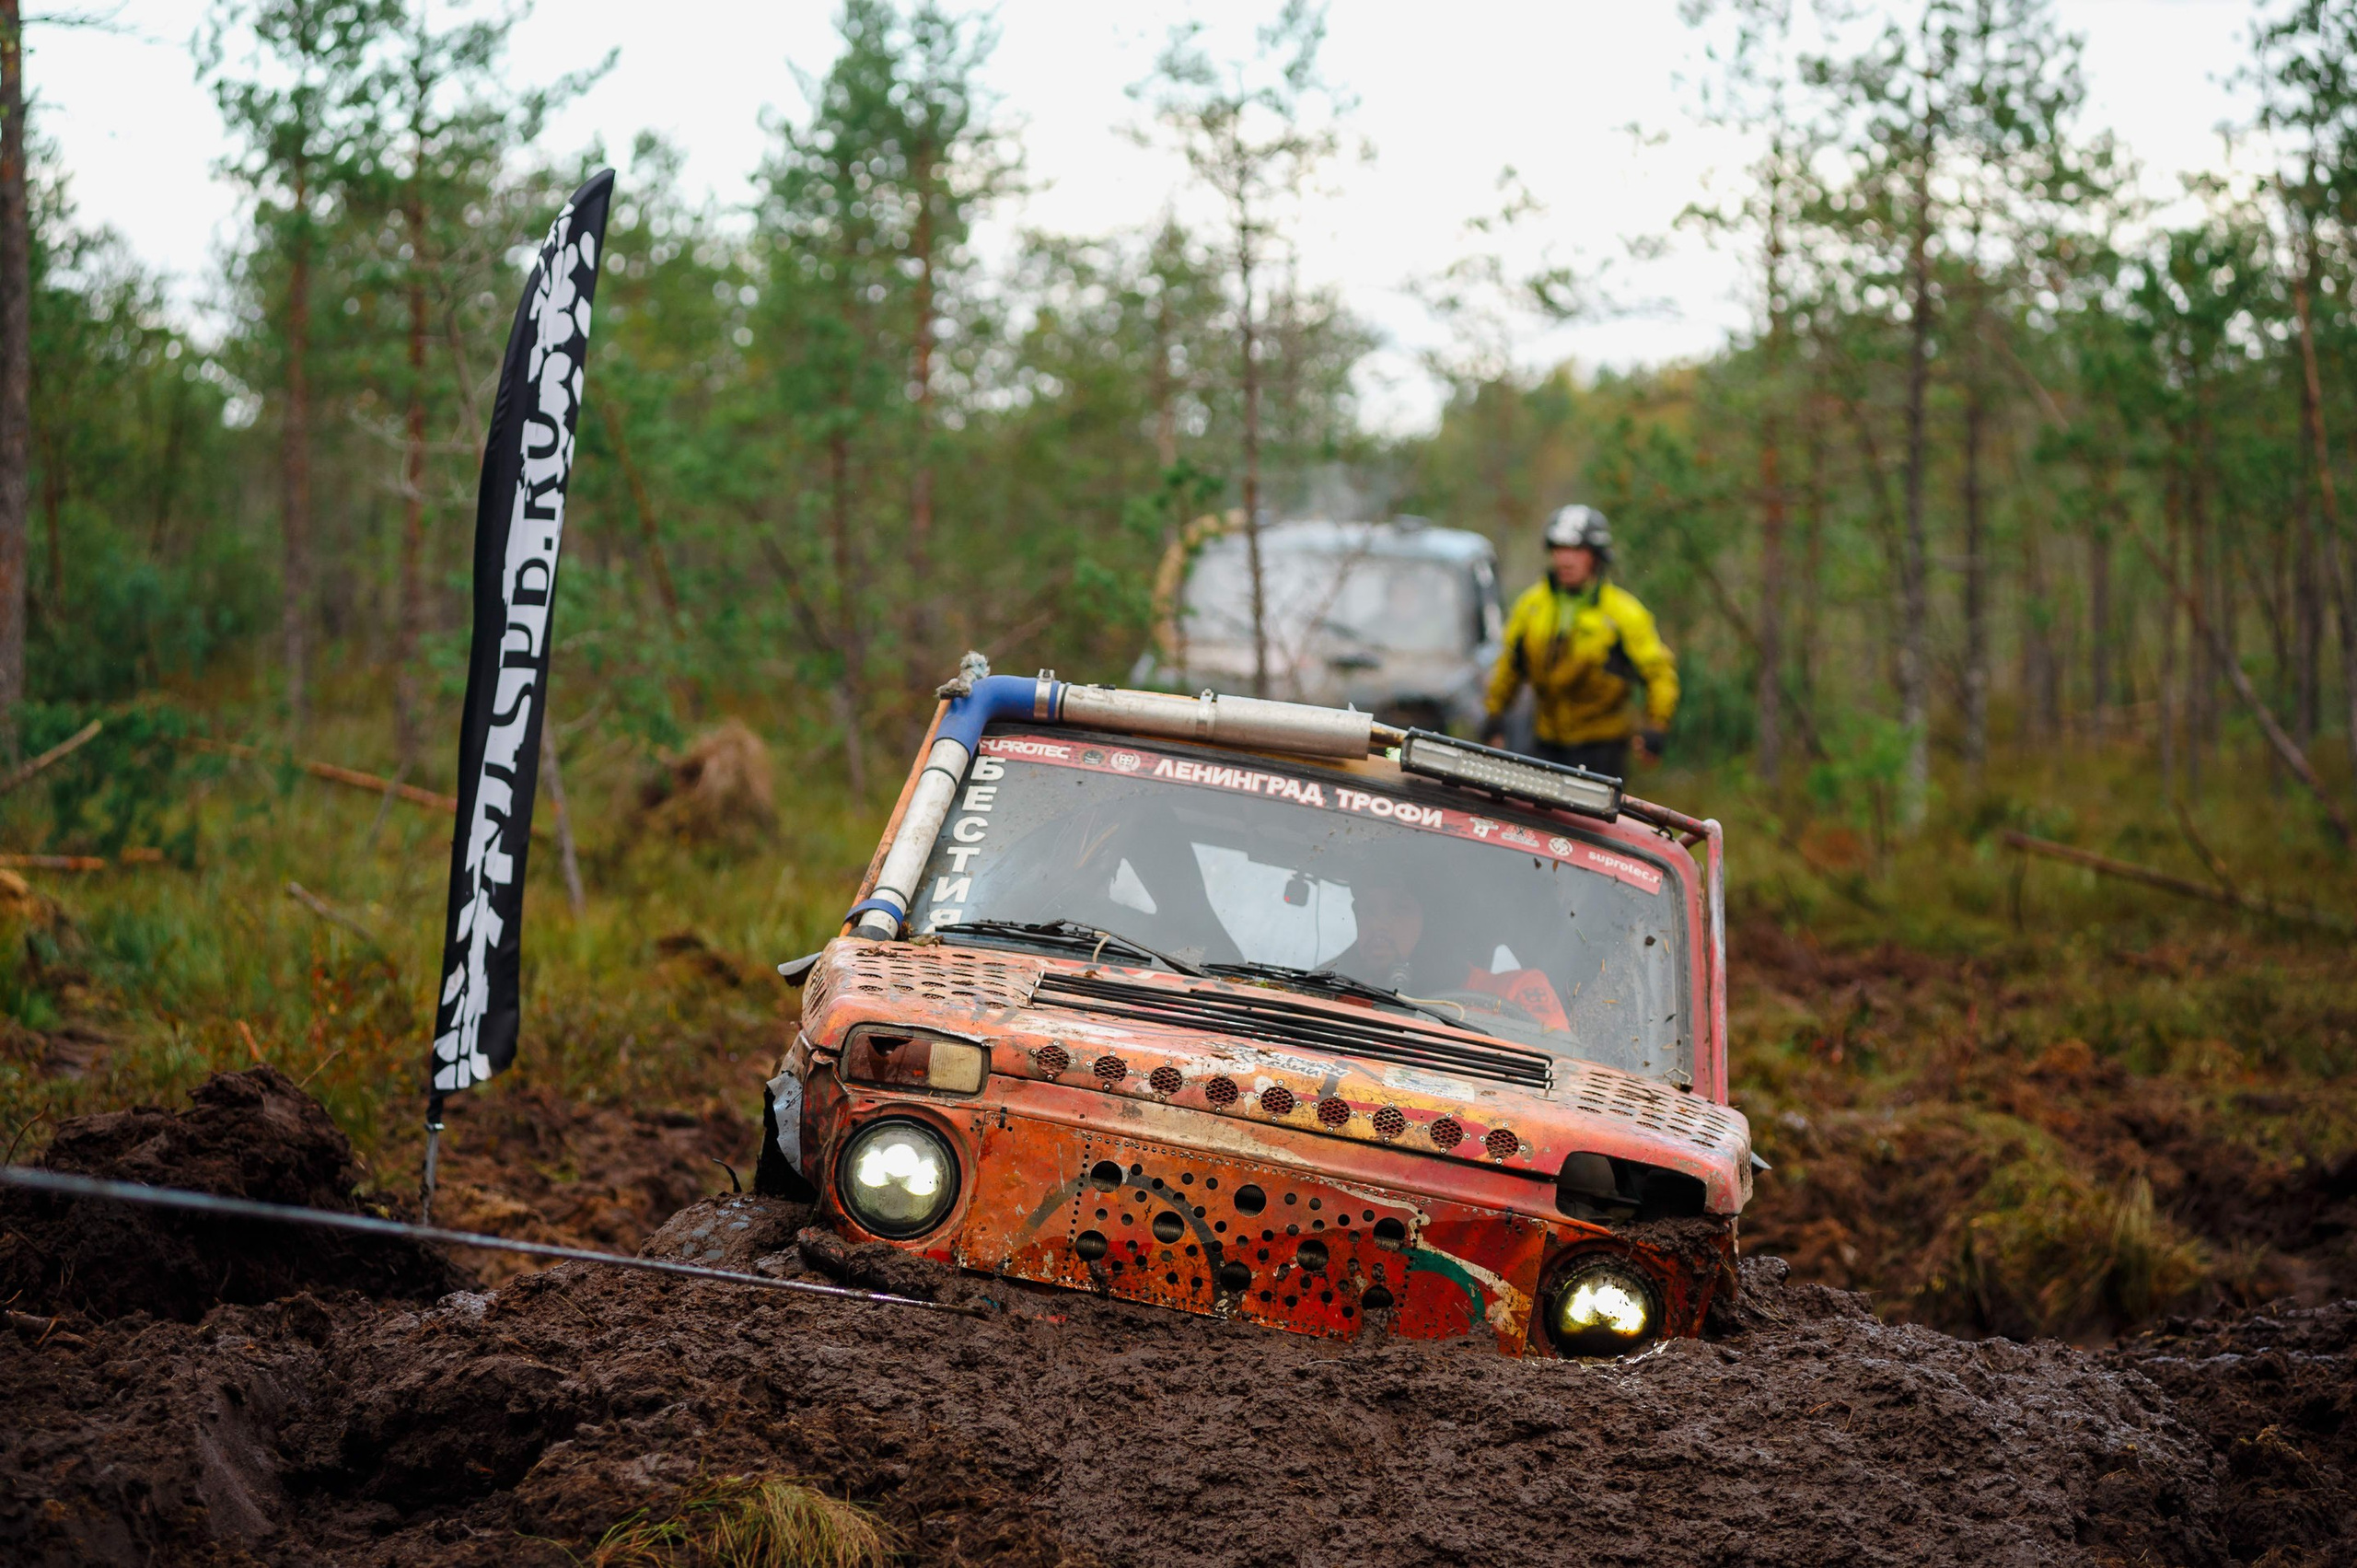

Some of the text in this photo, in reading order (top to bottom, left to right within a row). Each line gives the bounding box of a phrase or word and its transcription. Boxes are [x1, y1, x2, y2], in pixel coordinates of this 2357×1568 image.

[923, 755, 1006, 934] БЕСТИЯ
[1154, 758, 1444, 829] ЛЕНИНГРАД ТРОФИ
